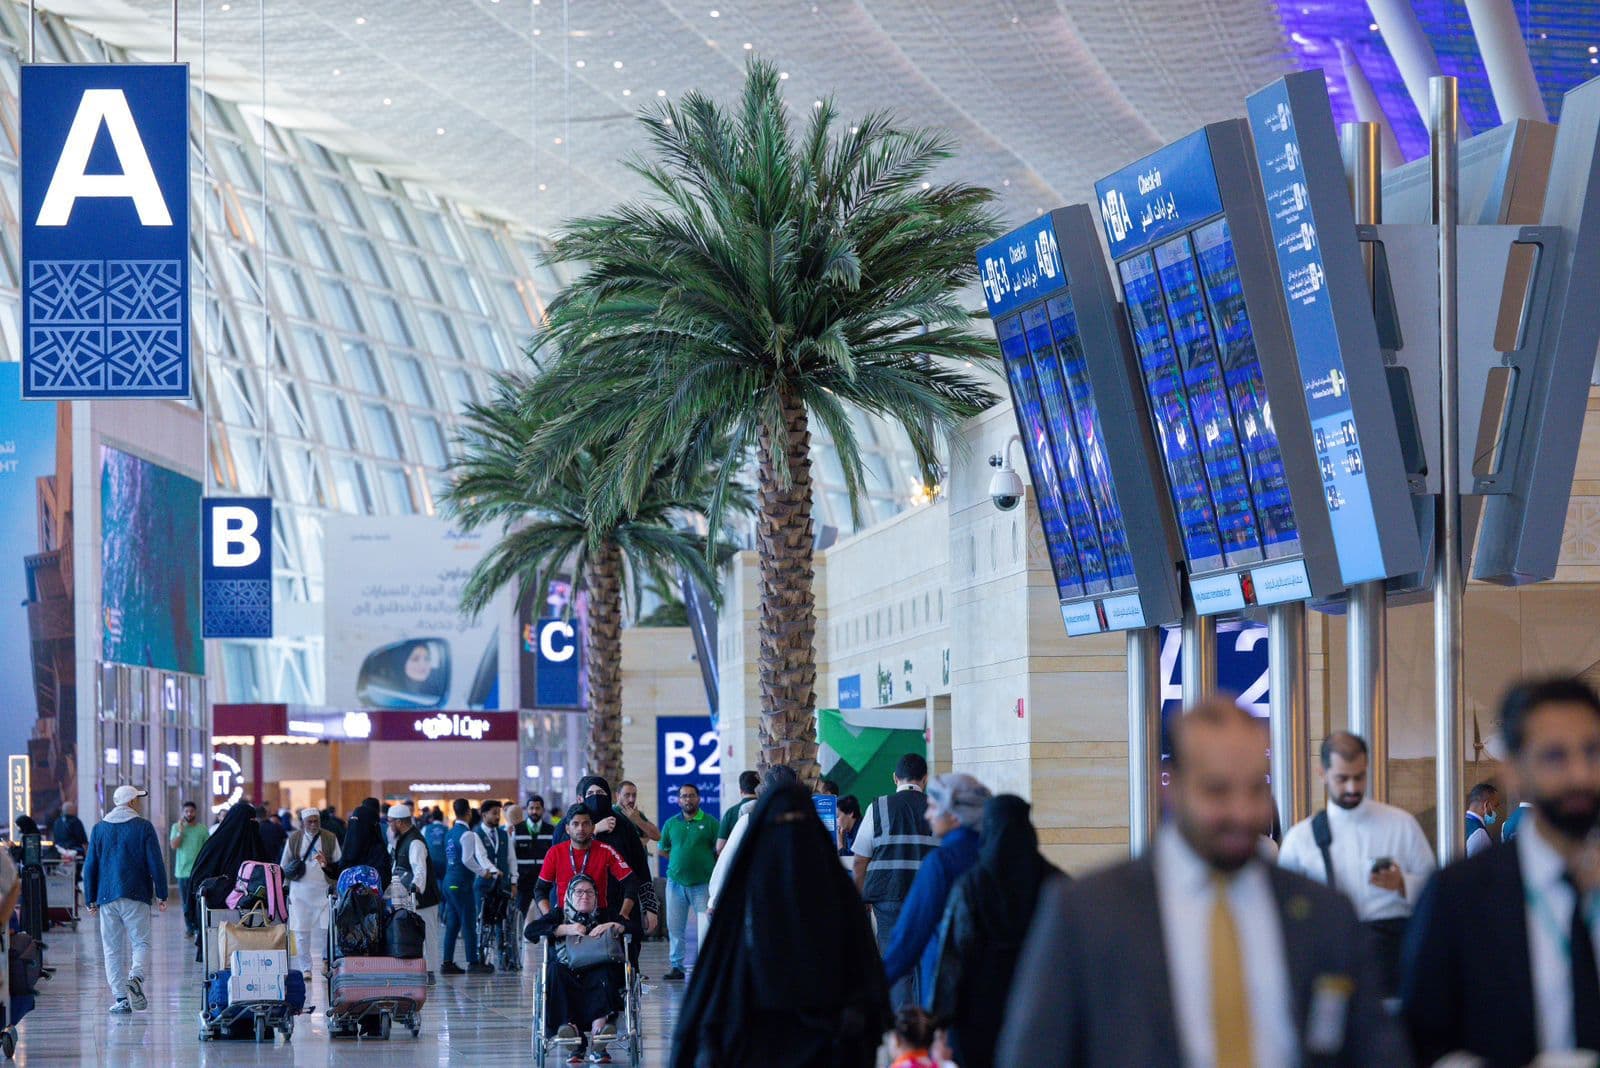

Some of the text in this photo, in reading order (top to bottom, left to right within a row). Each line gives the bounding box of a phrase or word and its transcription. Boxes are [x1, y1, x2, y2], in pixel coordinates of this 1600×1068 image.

[36, 89, 173, 226] A
[1137, 167, 1161, 195] Check-in
[1119, 192, 1133, 232] A
[1008, 241, 1028, 264] Check-in
[1034, 240, 1047, 276] A
[212, 506, 261, 567] B
[540, 621, 575, 662] C
[665, 730, 720, 775] B2
